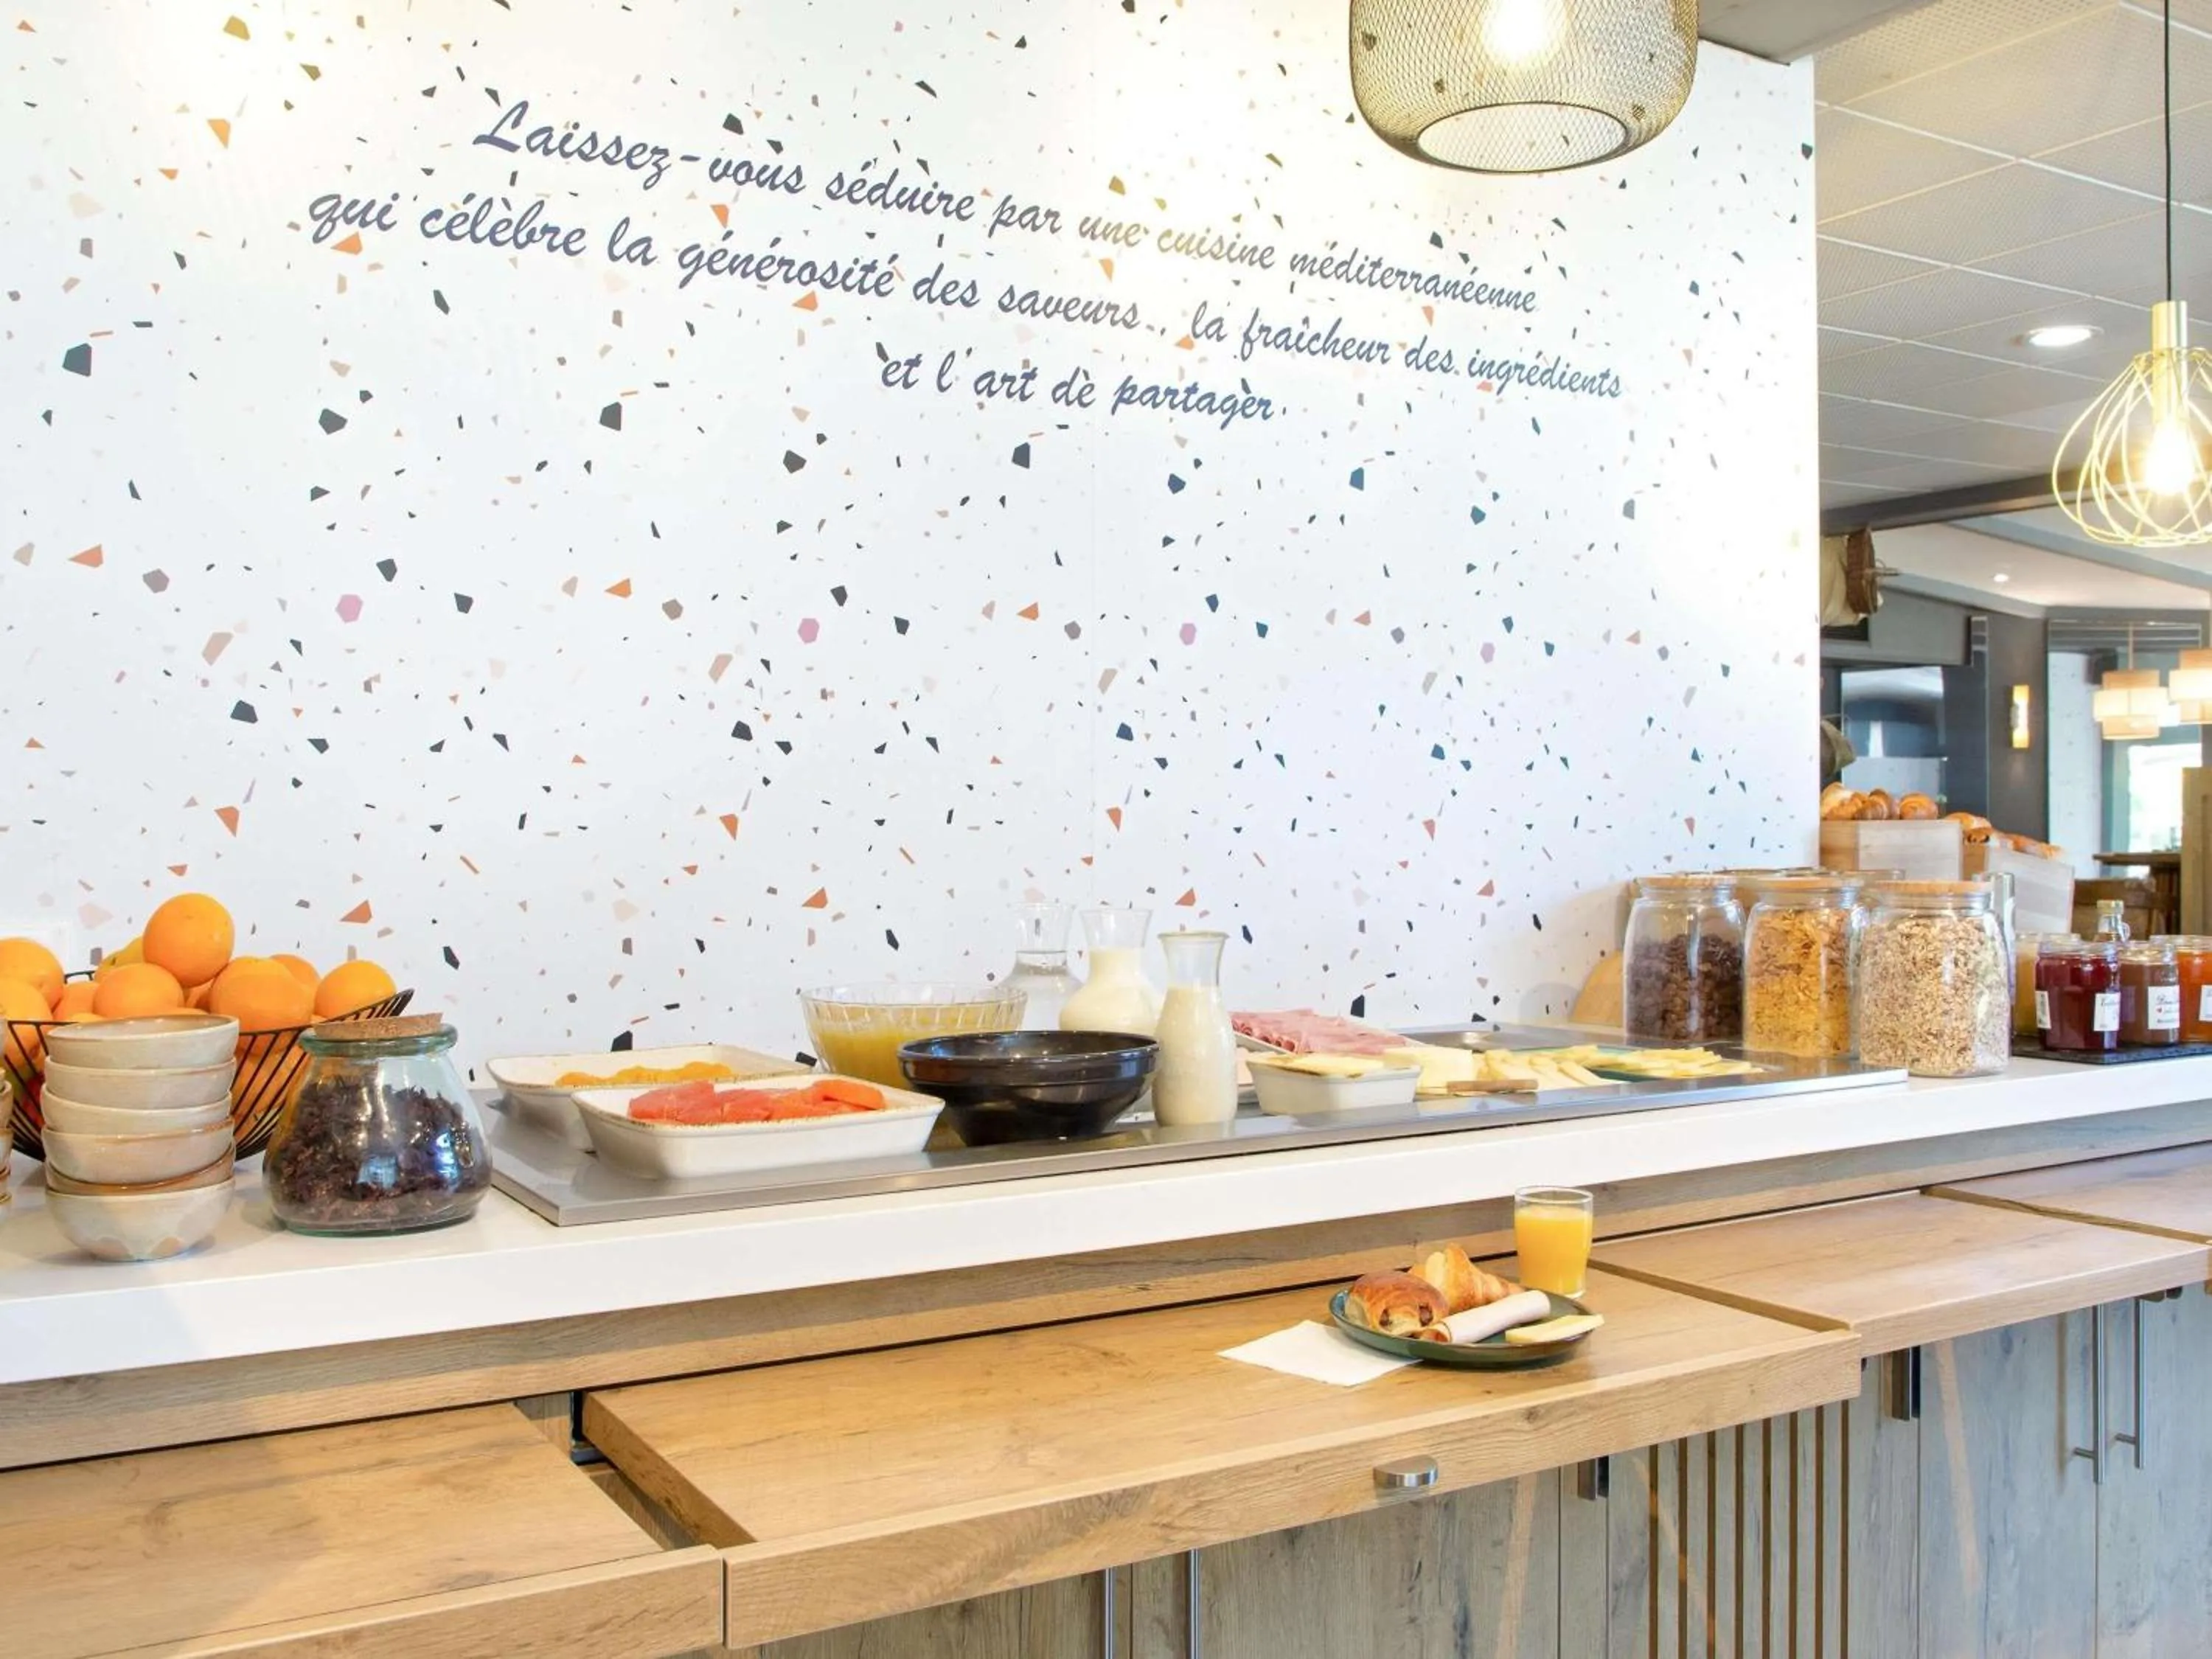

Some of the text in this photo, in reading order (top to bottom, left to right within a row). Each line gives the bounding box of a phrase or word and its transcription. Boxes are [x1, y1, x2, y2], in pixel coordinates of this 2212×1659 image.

[309, 192, 397, 243] qui
[420, 192, 587, 256] célèbre
[608, 217, 657, 265] la
[678, 229, 898, 297] générosité
[913, 262, 980, 307] des
[1192, 301, 1228, 341] la
[1241, 307, 1391, 364] fraîcheur
[1405, 335, 1455, 374] des
[1467, 349, 1621, 397] ingrédients
[473, 100, 1536, 313] Laissez-vous séduire par une cuisine méditerranéenne
[882, 354, 922, 389] et
[1051, 366, 1096, 408] de
